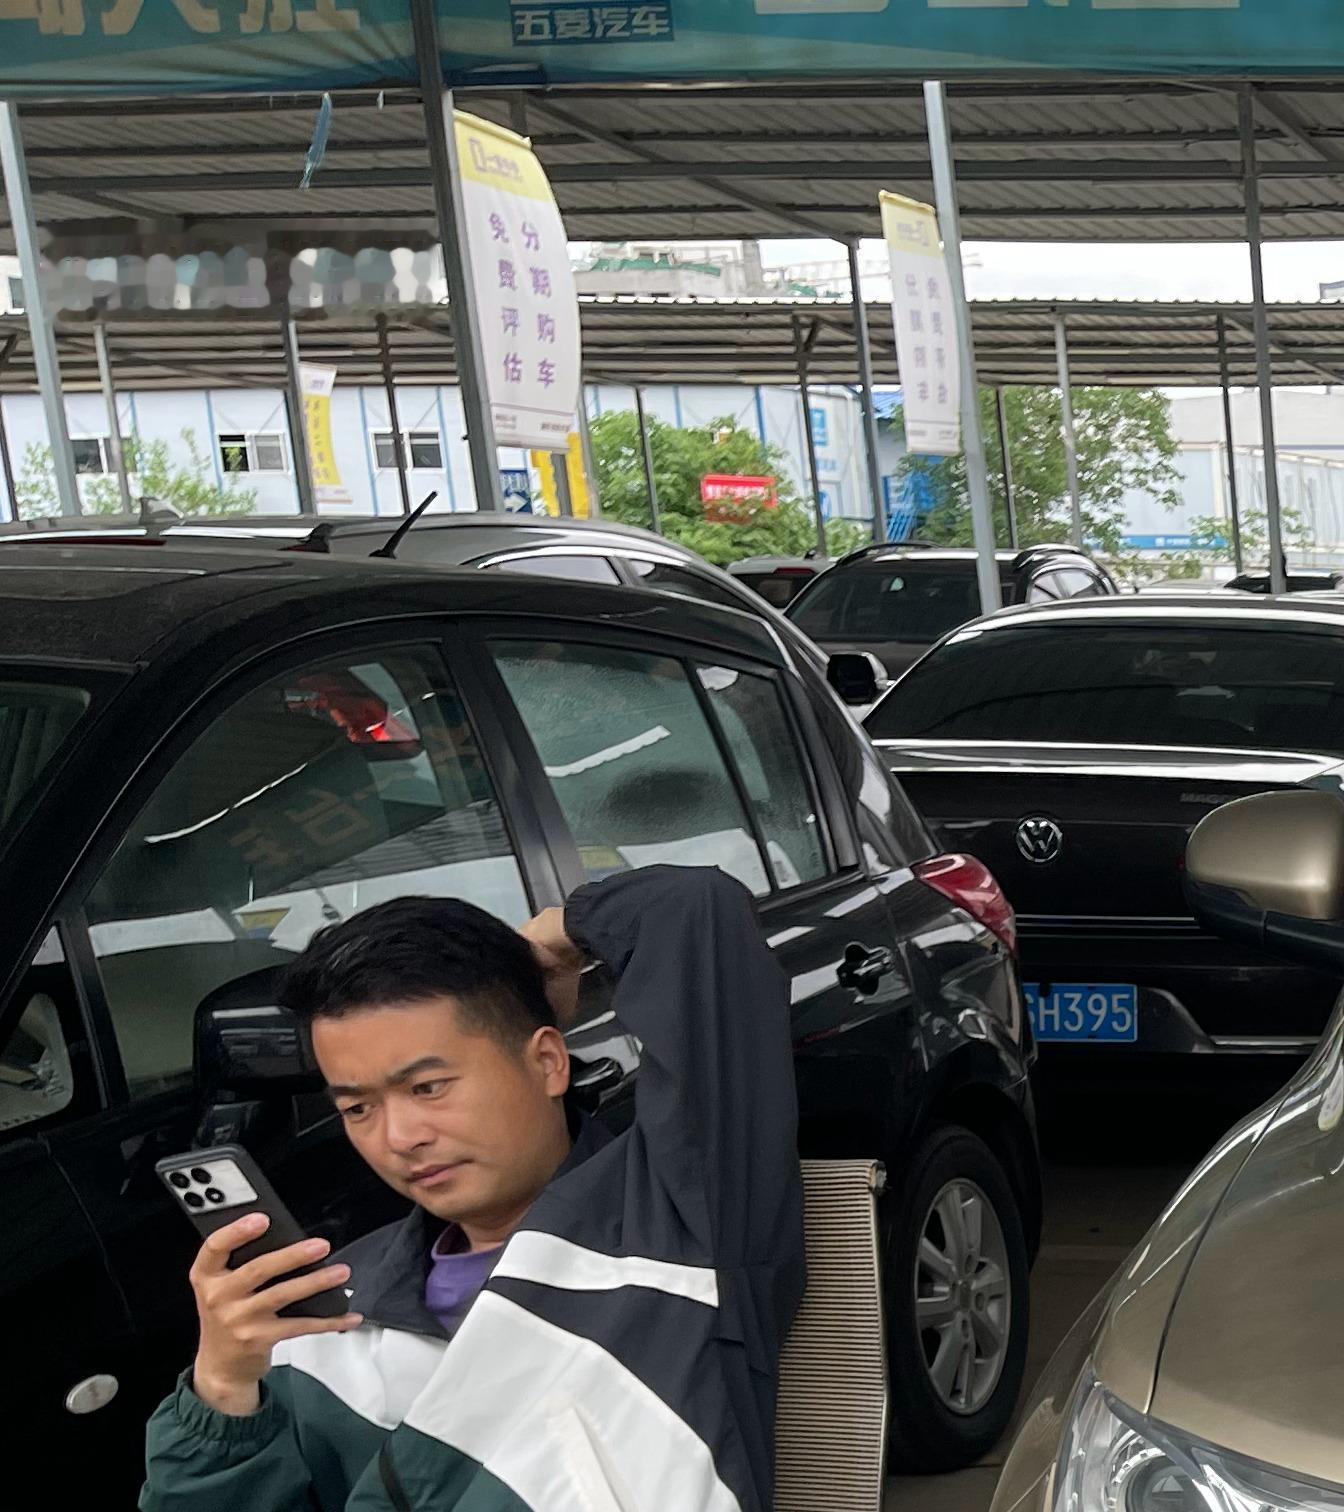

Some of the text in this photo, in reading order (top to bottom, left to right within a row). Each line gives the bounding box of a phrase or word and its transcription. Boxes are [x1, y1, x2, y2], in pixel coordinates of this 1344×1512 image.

[514, 6, 670, 41] 五菱汽车
[488, 212, 523, 383] 免费评估
[520, 221, 556, 388] 分期购车
